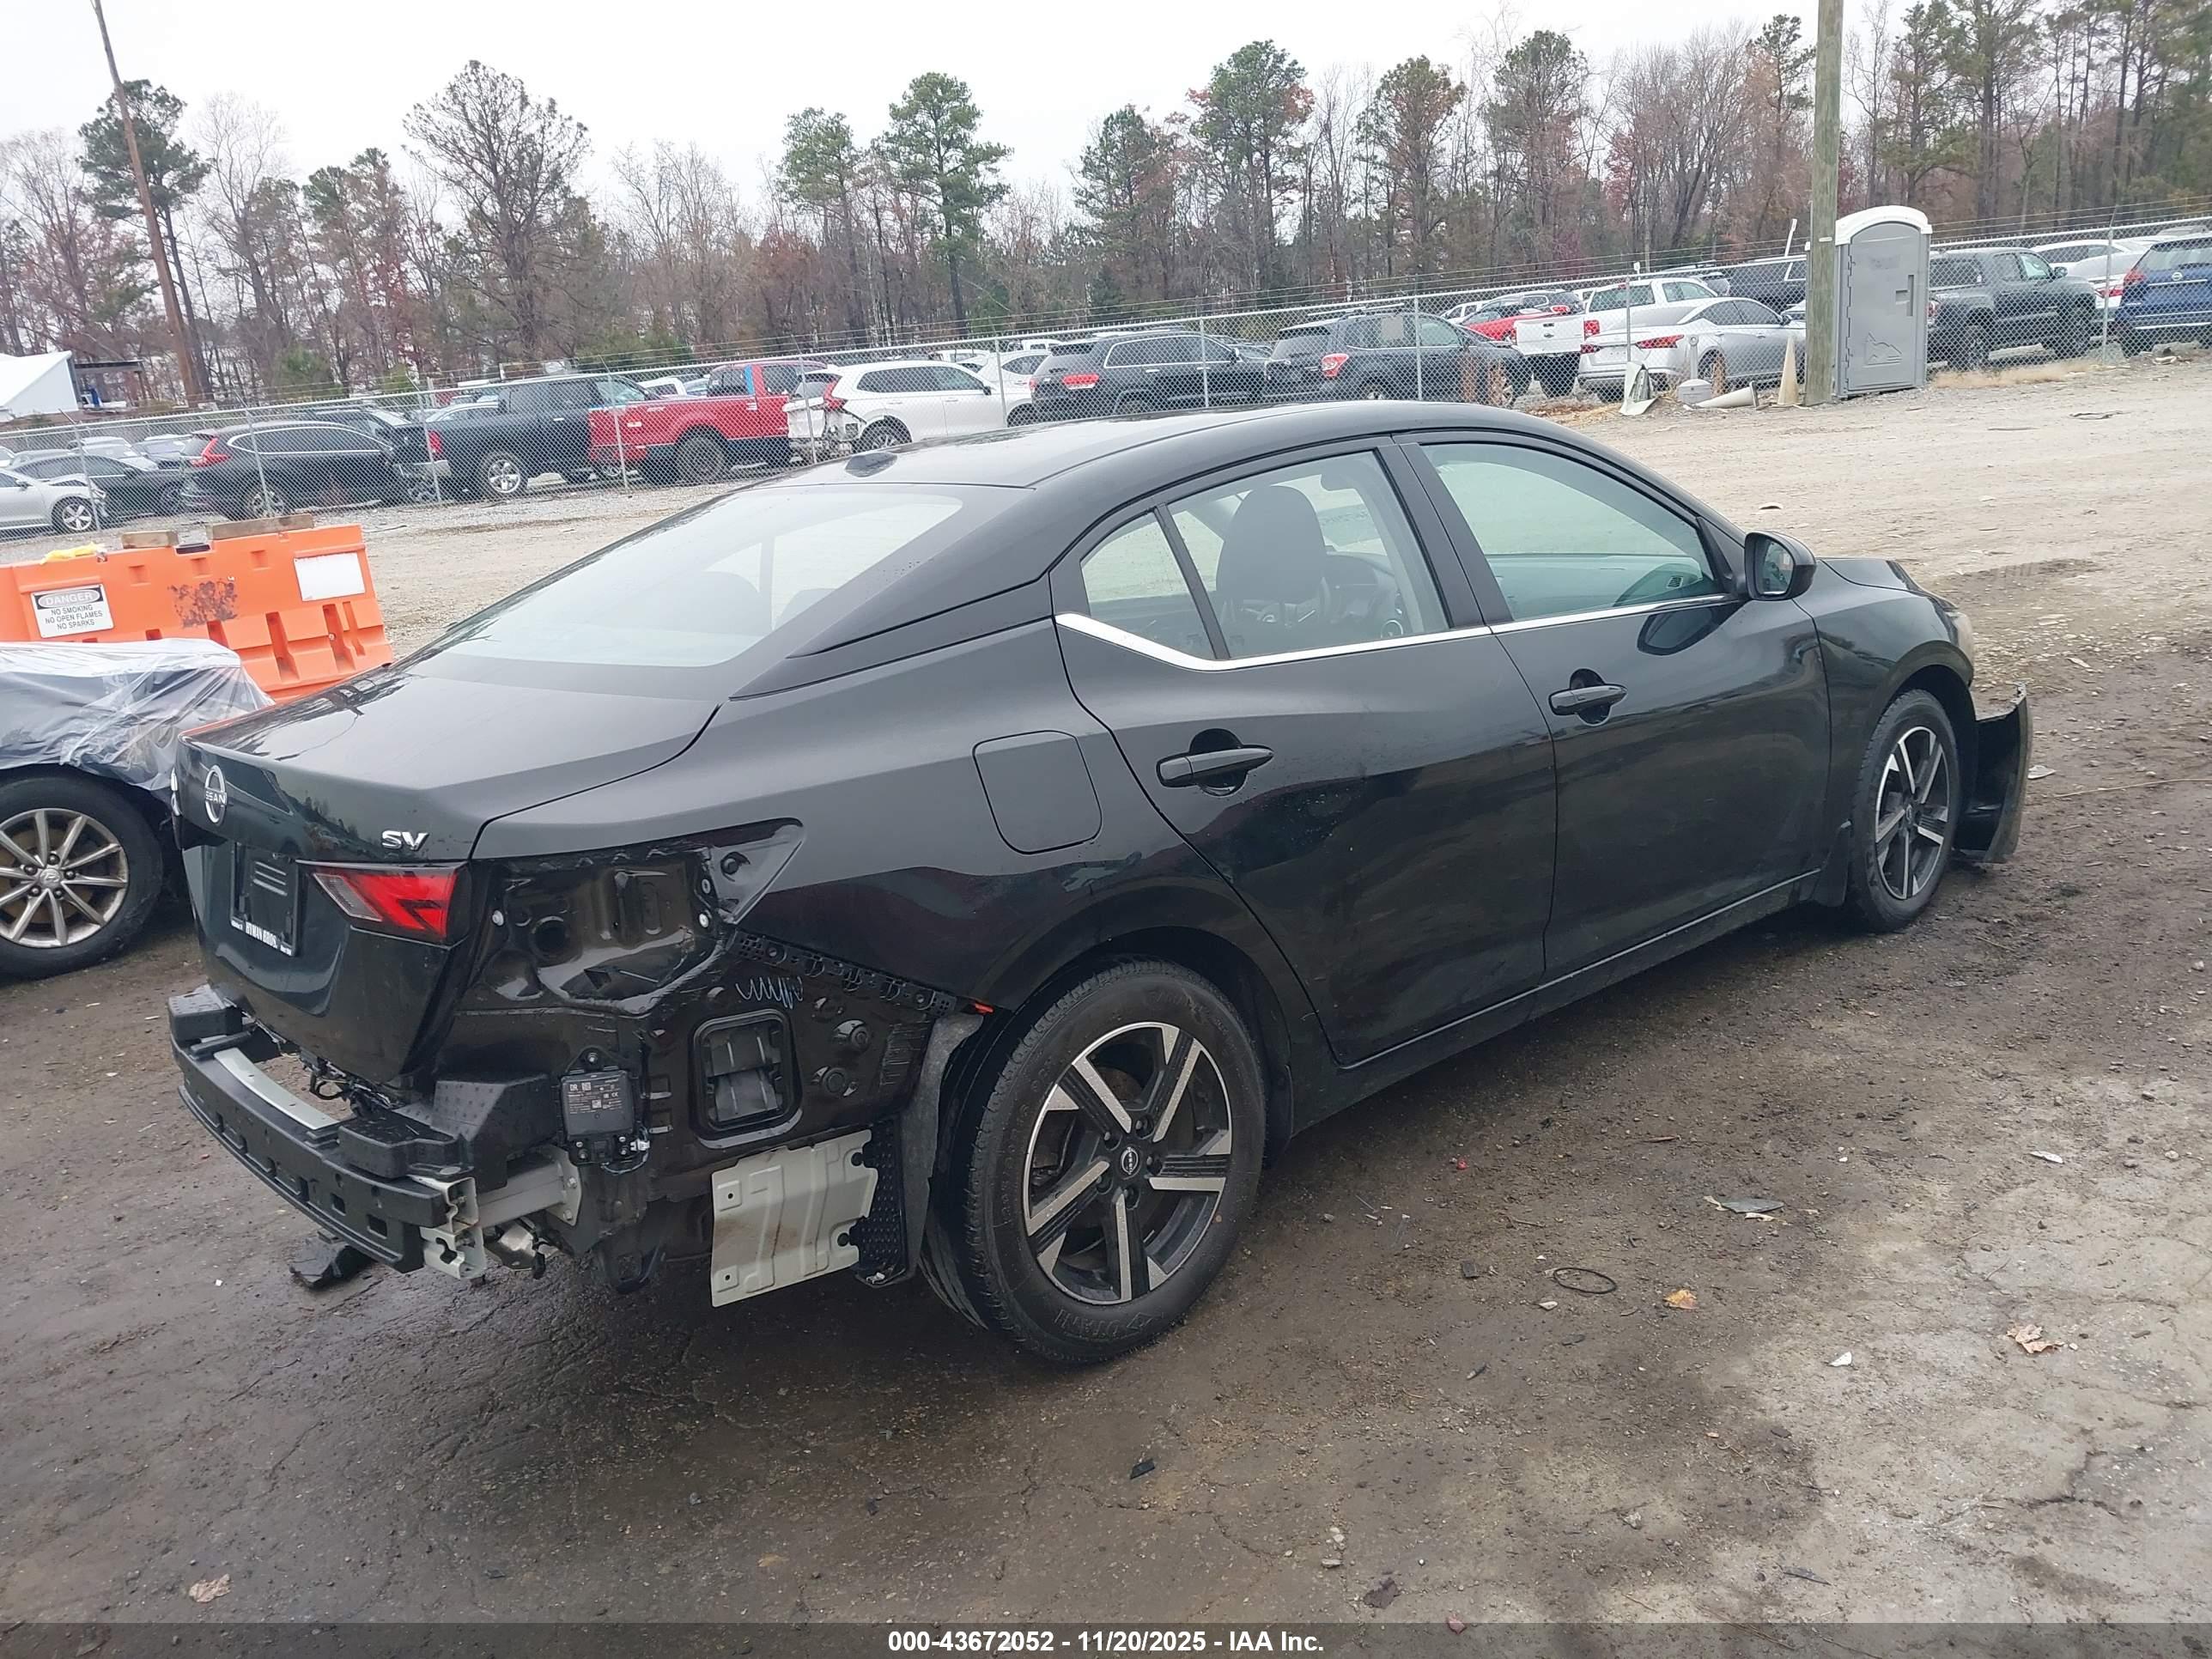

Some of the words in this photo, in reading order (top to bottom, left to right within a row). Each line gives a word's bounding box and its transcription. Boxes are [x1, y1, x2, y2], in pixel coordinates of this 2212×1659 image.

[46, 592, 94, 605] DANGER
[62, 605, 94, 613] SMOKING
[76, 611, 103, 619] FLAMES
[68, 619, 95, 629] SPARKS
[382, 830, 428, 851] SV
